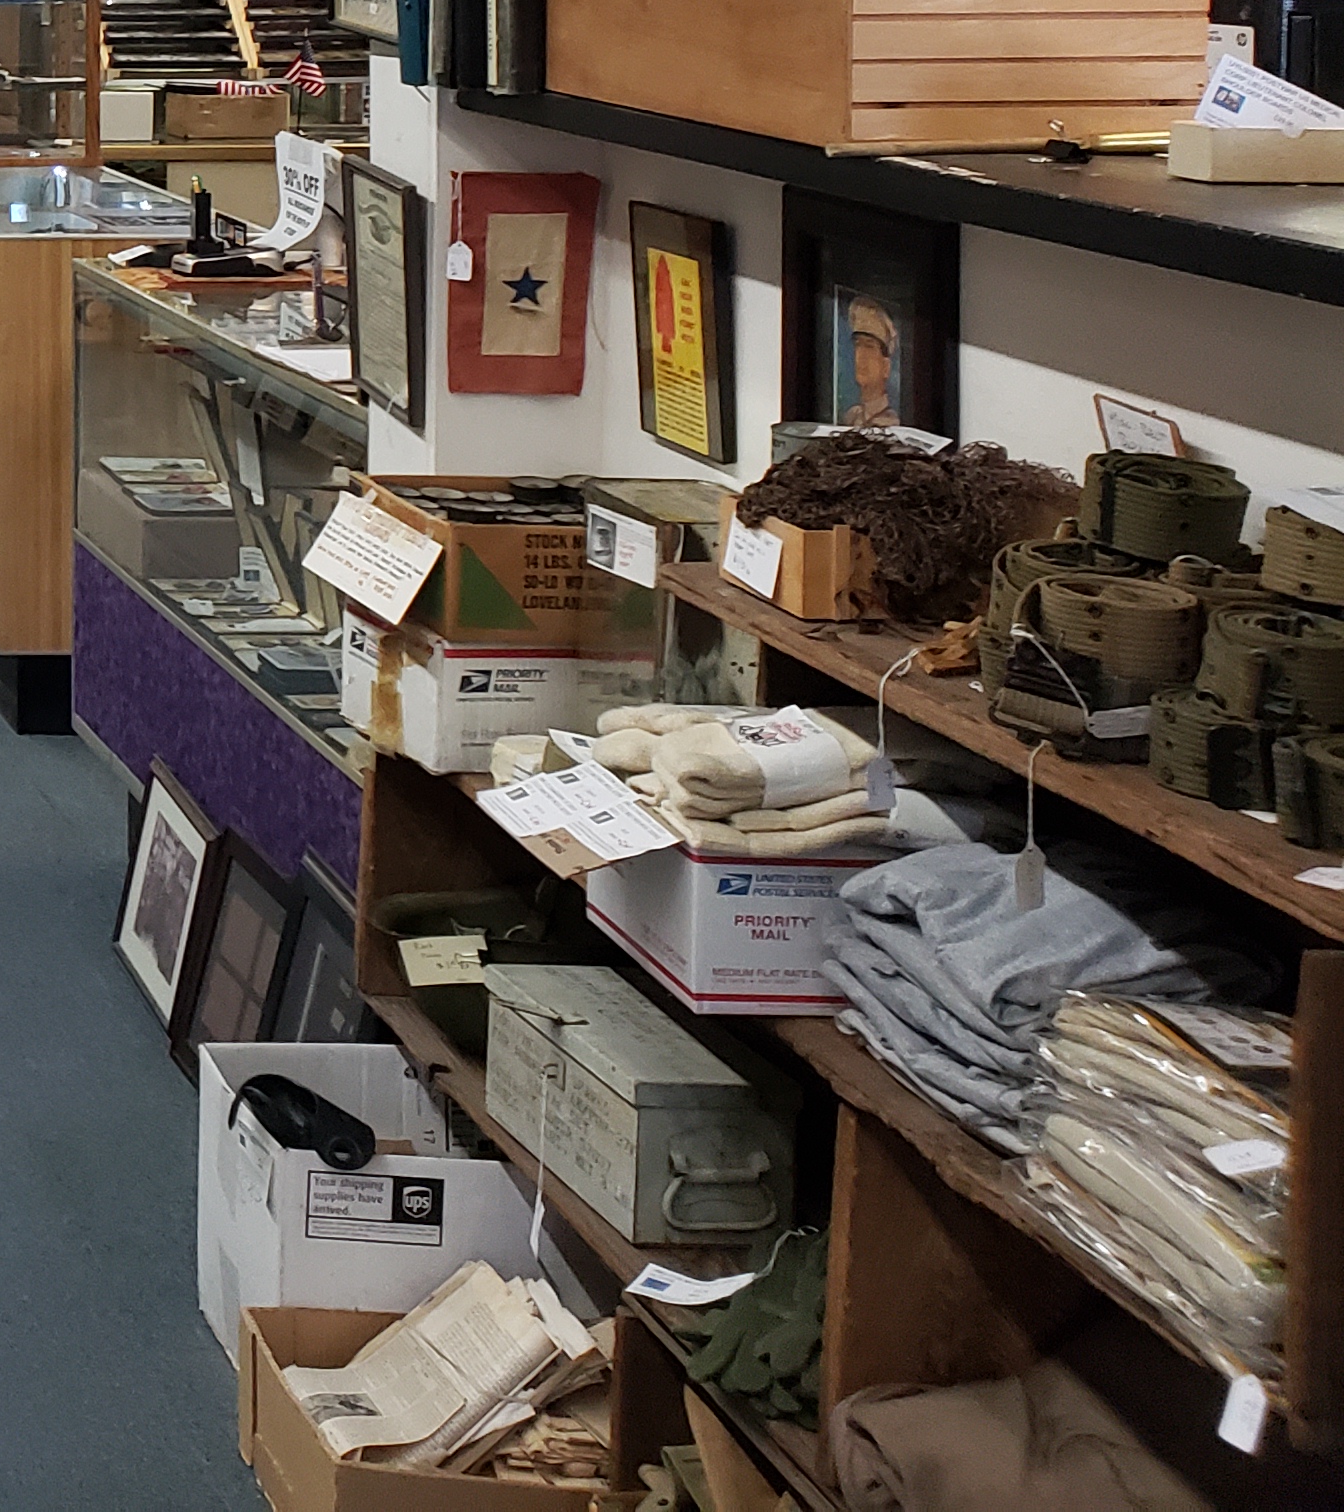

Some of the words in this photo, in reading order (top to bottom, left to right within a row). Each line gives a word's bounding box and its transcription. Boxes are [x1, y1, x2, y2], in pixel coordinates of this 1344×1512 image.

[303, 173, 320, 197] OFF
[525, 533, 563, 549] STOCK
[525, 554, 538, 568] 14
[543, 554, 570, 569] LBS.
[495, 669, 546, 679] PRIORITY
[494, 683, 521, 693] MAIL
[755, 874, 795, 883] UNITED
[797, 875, 833, 884] STATES
[752, 888, 791, 897] POSTAL
[792, 889, 840, 898] SERVICE
[734, 915, 812, 928] PRIORITY
[751, 929, 791, 941] MAIL
[712, 968, 754, 977] MEDIUM
[756, 968, 780, 977] FLAT
[784, 969, 811, 978] RATE
[314, 1176, 337, 1187] Your
[339, 1177, 385, 1193] shipping
[313, 1191, 355, 1203] supplies
[358, 1194, 384, 1205] have
[404, 1194, 430, 1213] ups
[313, 1204, 352, 1216] arrived.
